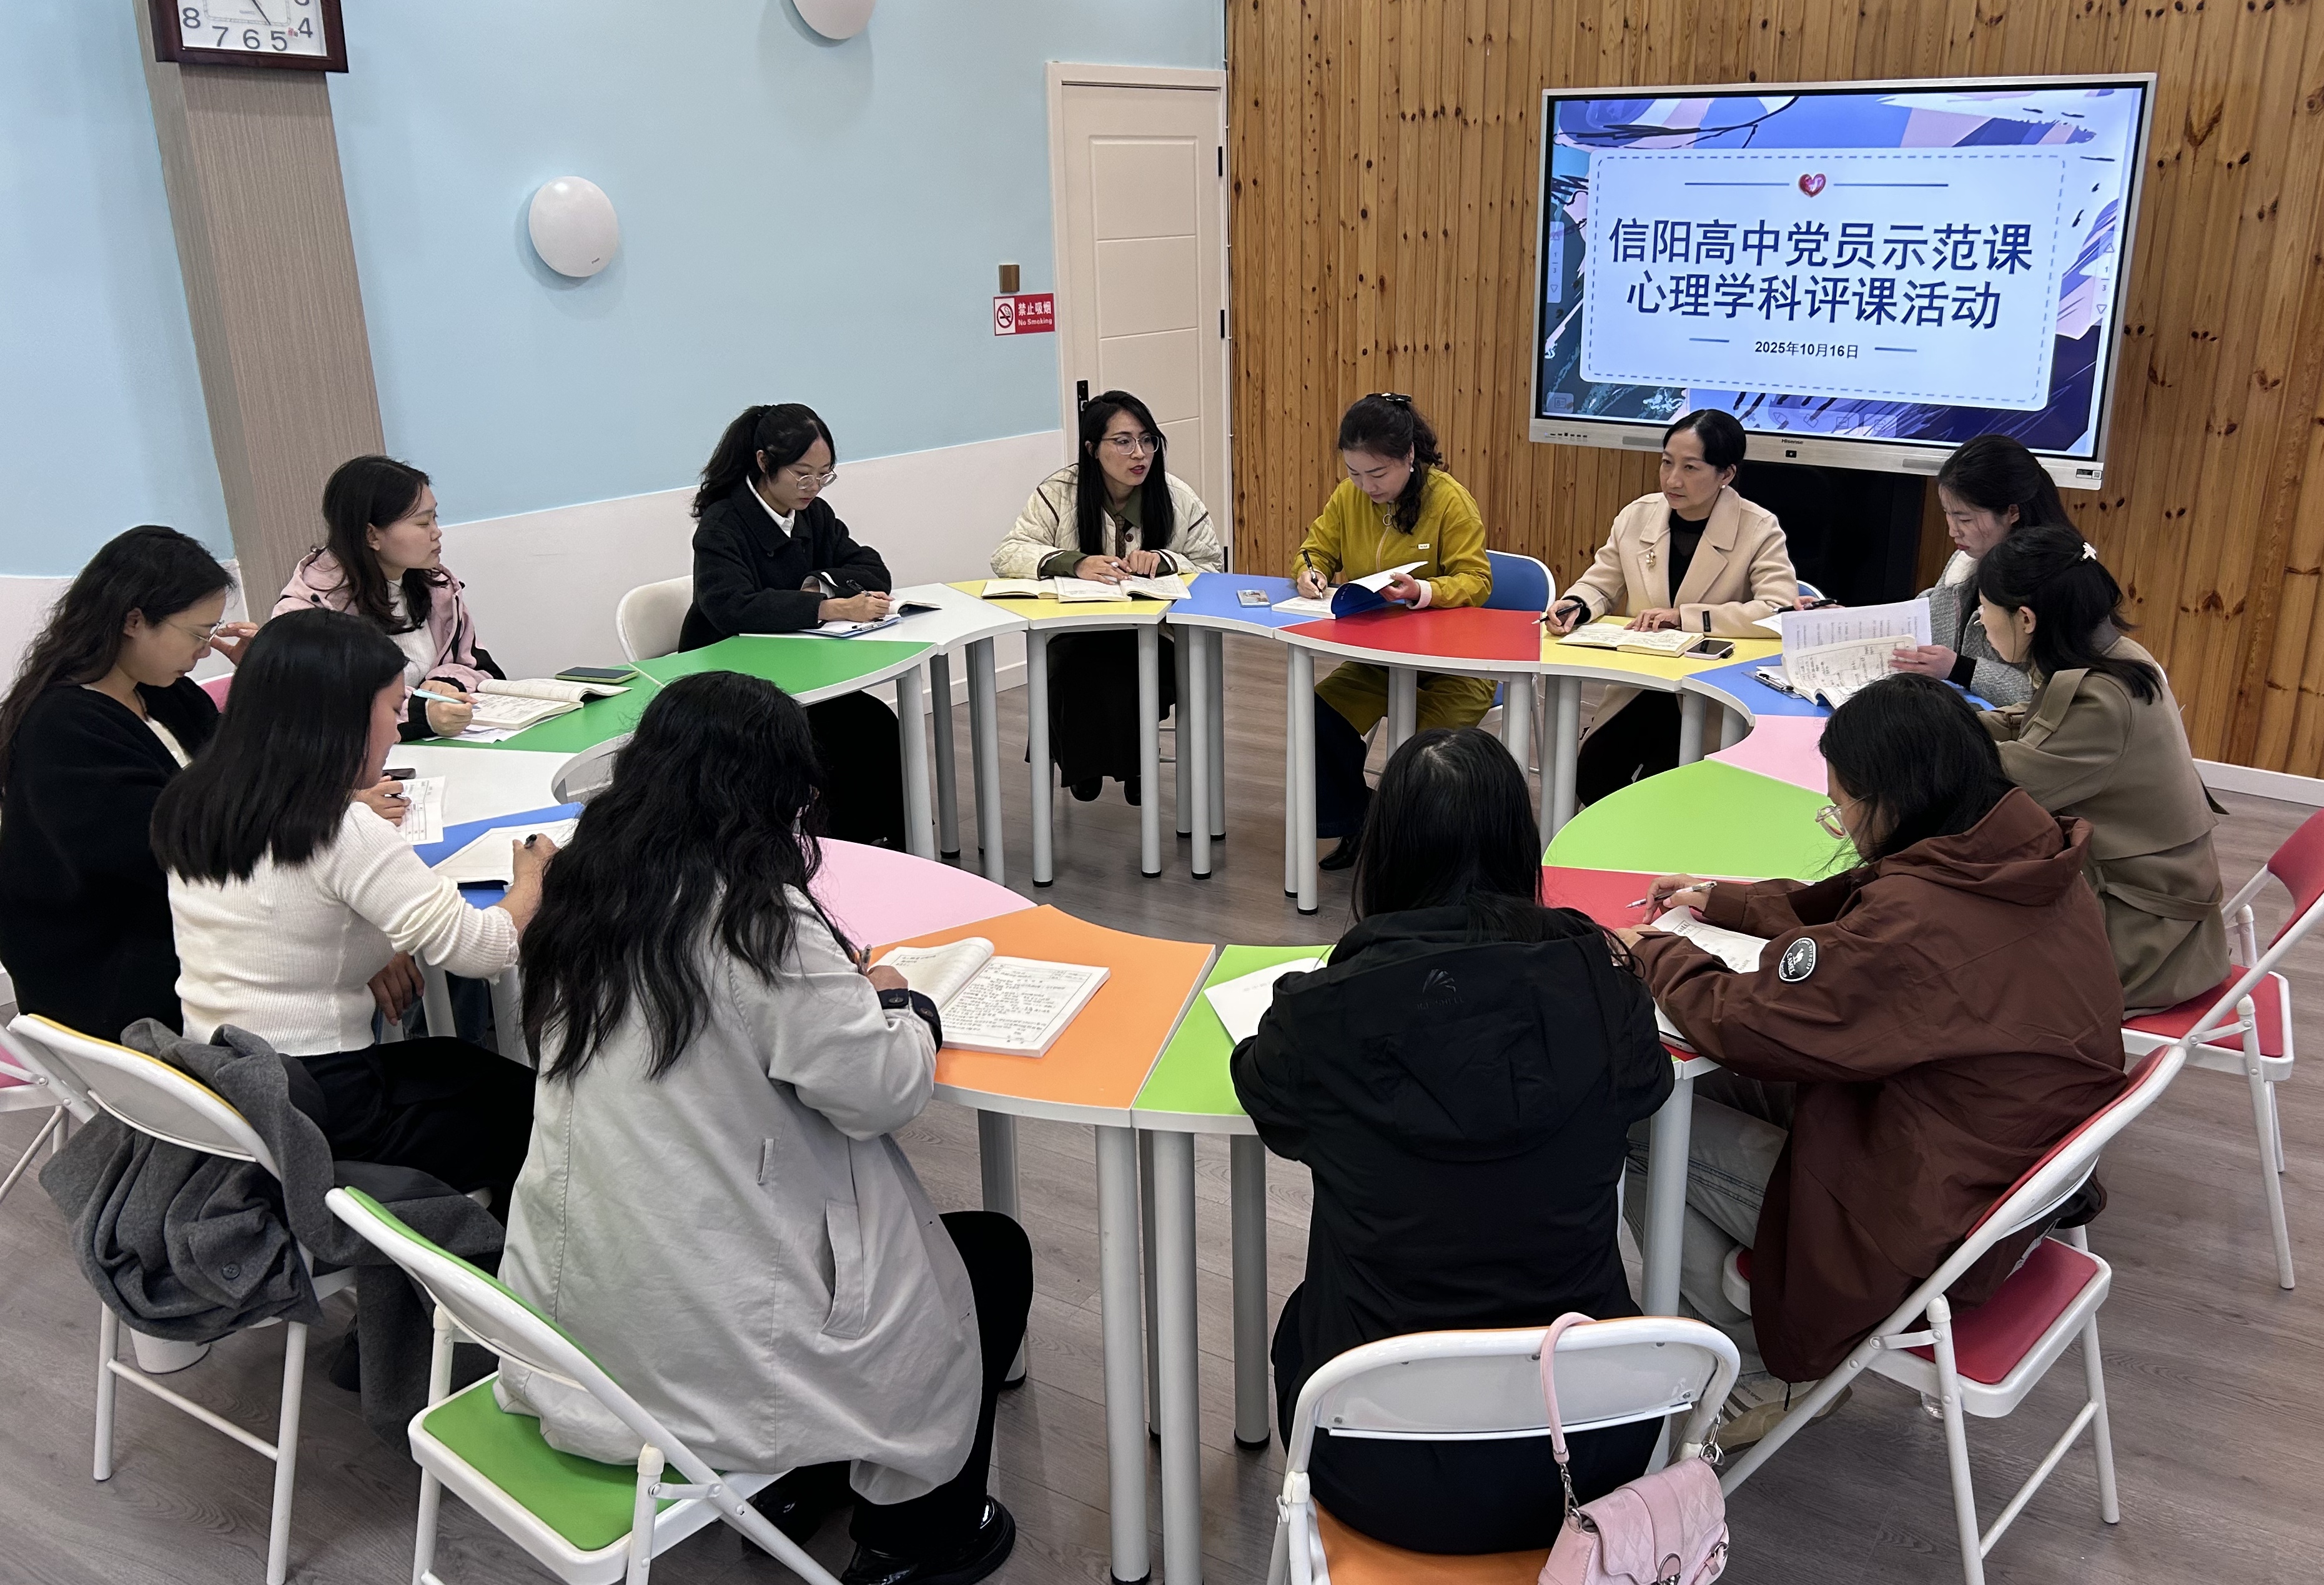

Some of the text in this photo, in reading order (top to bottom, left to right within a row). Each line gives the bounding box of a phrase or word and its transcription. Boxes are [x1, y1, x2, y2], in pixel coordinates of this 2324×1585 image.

[182, 7, 201, 29] 8
[298, 17, 313, 38] 4
[212, 26, 229, 47] 7
[242, 29, 260, 49] 6
[270, 30, 287, 52] 5
[1608, 217, 2032, 275] 信阳高中党员示范课
[1018, 301, 1052, 317] 禁止吸烟
[1626, 269, 2000, 329] 心理学科评课活动
[1027, 317, 1052, 325] Smoking
[1754, 341, 1859, 359] 2025年10月16日
[1786, 952, 1796, 976] CAMEL
